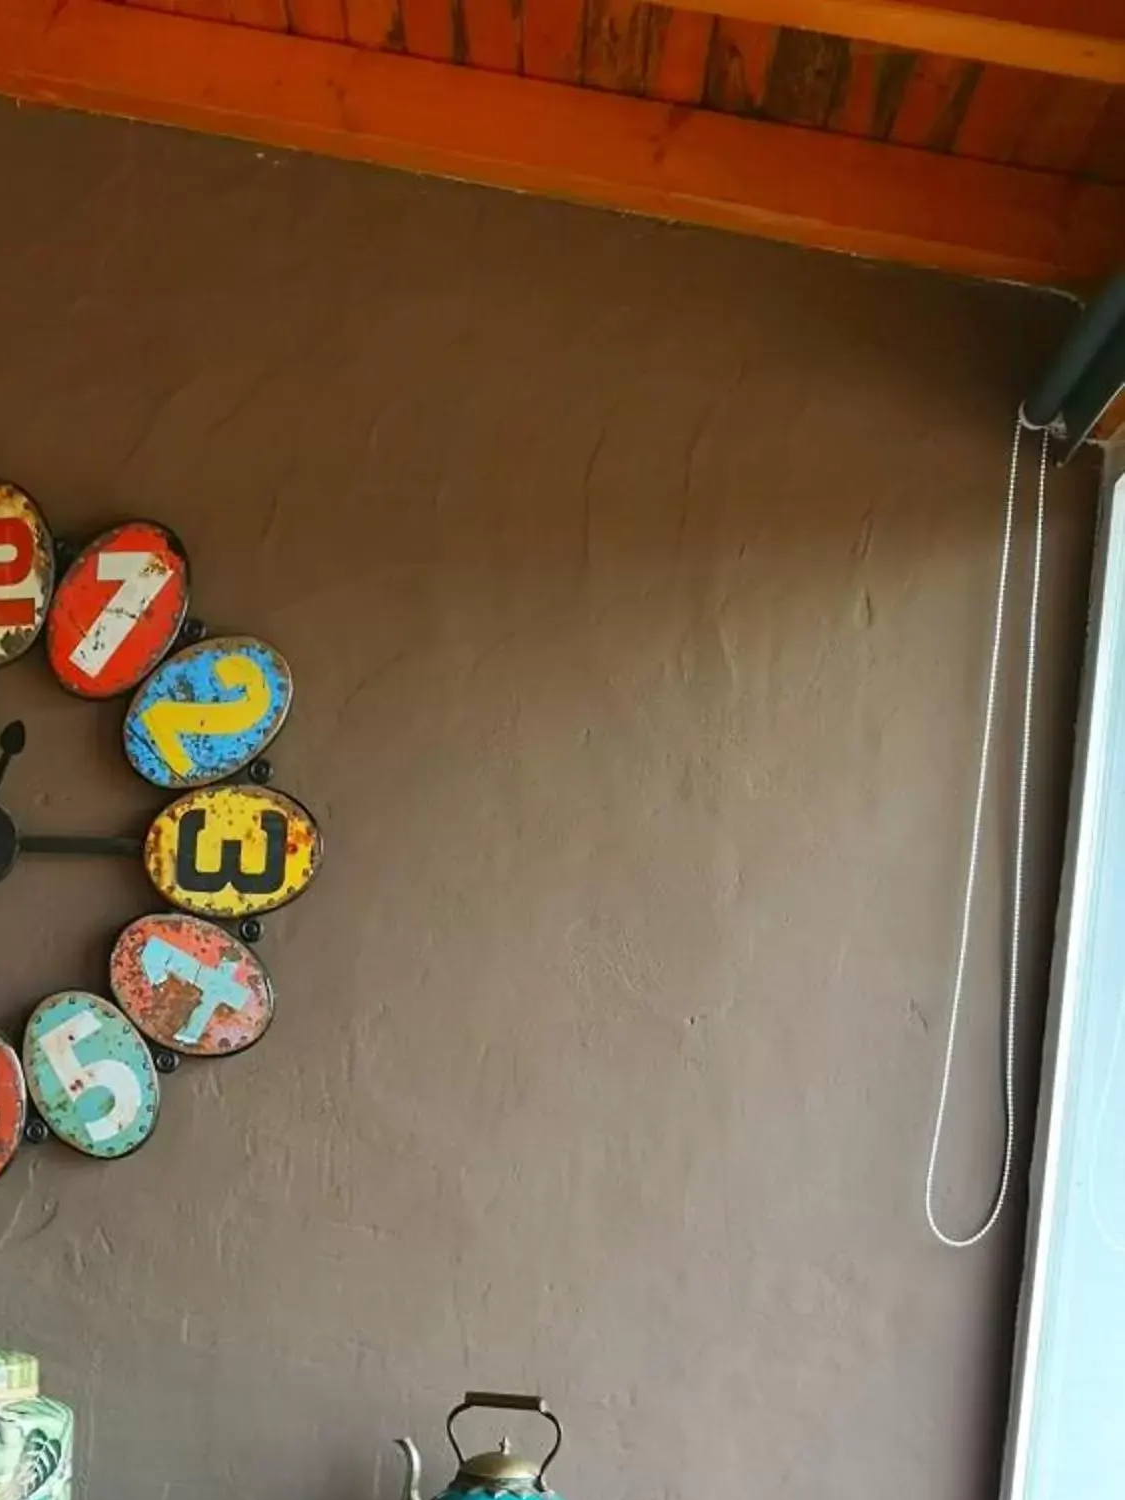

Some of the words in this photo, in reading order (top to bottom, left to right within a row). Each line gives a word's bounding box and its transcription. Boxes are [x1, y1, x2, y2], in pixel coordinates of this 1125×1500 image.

[141, 655, 271, 774] 2
[176, 807, 287, 894] 3
[139, 935, 258, 1044] 4
[40, 1010, 141, 1143] 5
